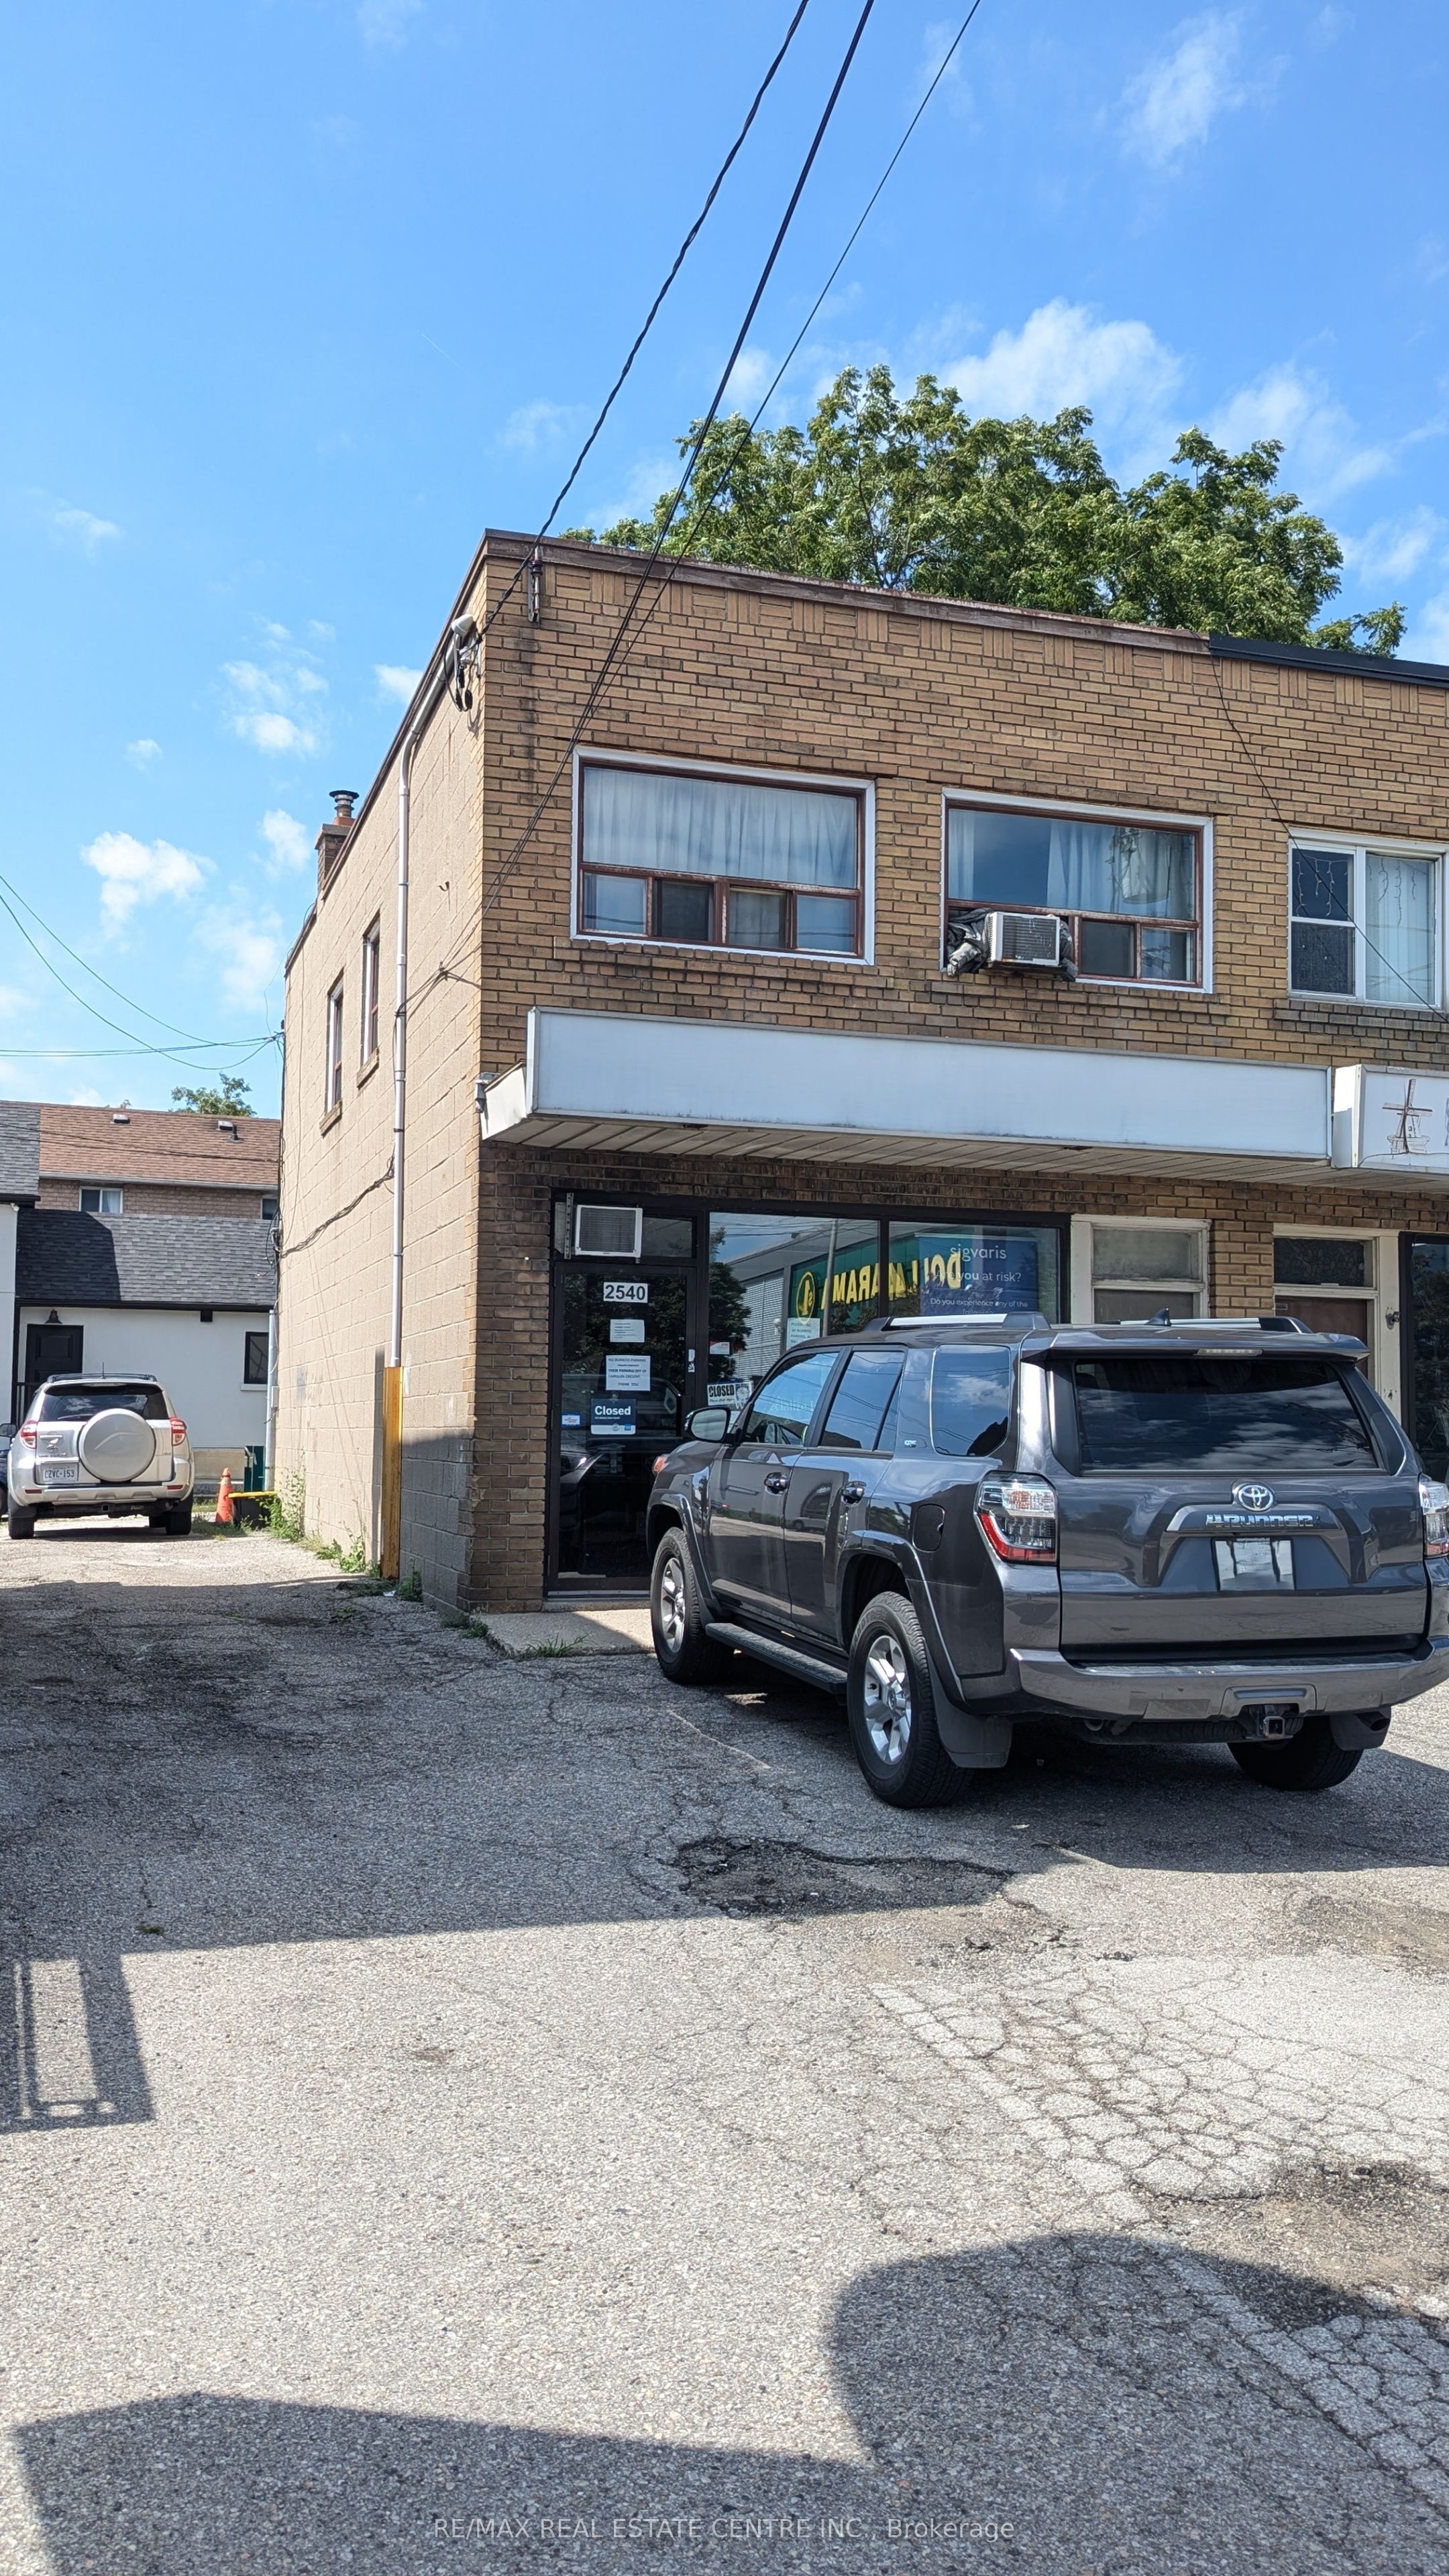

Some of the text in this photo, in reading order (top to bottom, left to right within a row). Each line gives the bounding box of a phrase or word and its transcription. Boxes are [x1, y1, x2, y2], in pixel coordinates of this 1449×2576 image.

[950, 1244, 1007, 1262] sigvaris
[958, 1272, 979, 1283] you
[982, 1273, 993, 1281] at
[996, 1271, 1022, 1283] risk?
[605, 1285, 645, 1300] 2540
[957, 1299, 993, 1307] experience
[708, 1384, 735, 1397] CLOSED
[595, 1406, 631, 1415] Closed
[1205, 1514, 1313, 1527] 4RUNNER
